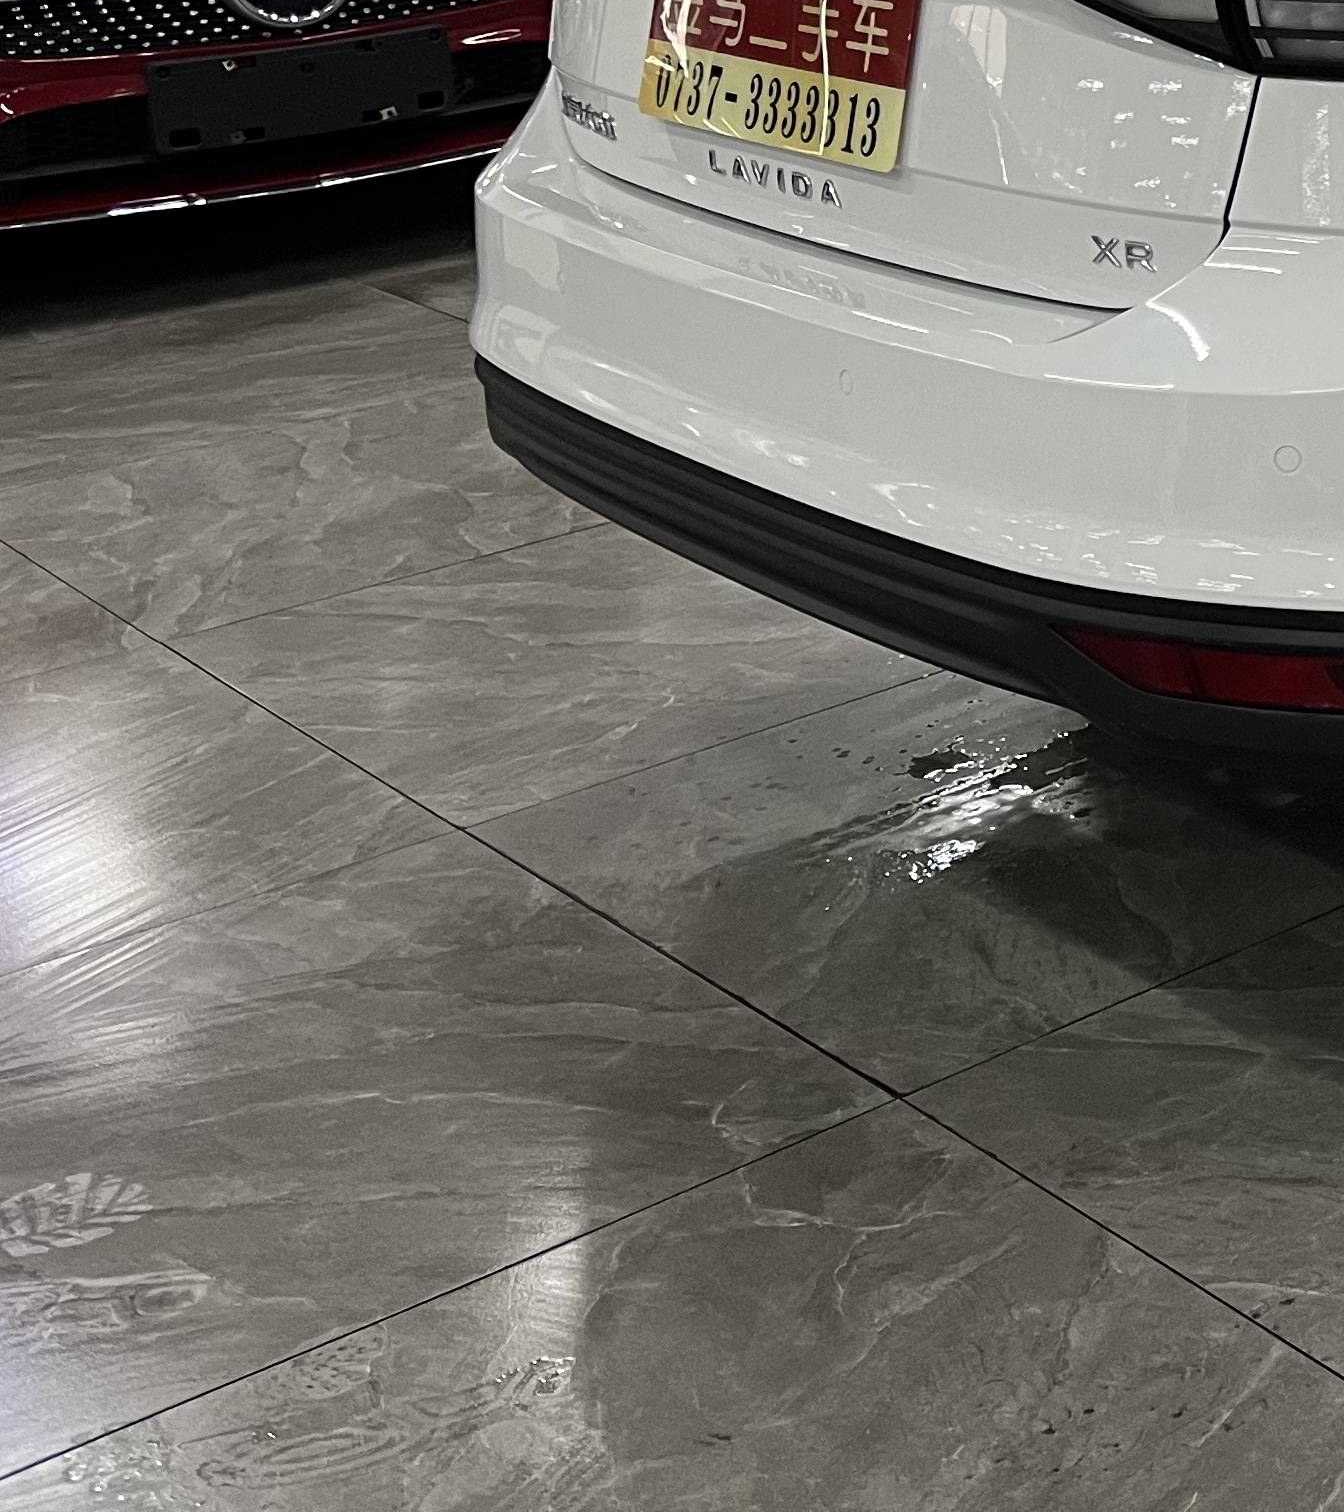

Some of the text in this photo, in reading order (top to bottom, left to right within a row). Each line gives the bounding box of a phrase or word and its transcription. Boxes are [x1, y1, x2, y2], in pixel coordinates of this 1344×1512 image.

[656, 54, 880, 157] 0737-3333313
[708, 148, 842, 209] LAVIDA
[1091, 235, 1158, 273] XR
